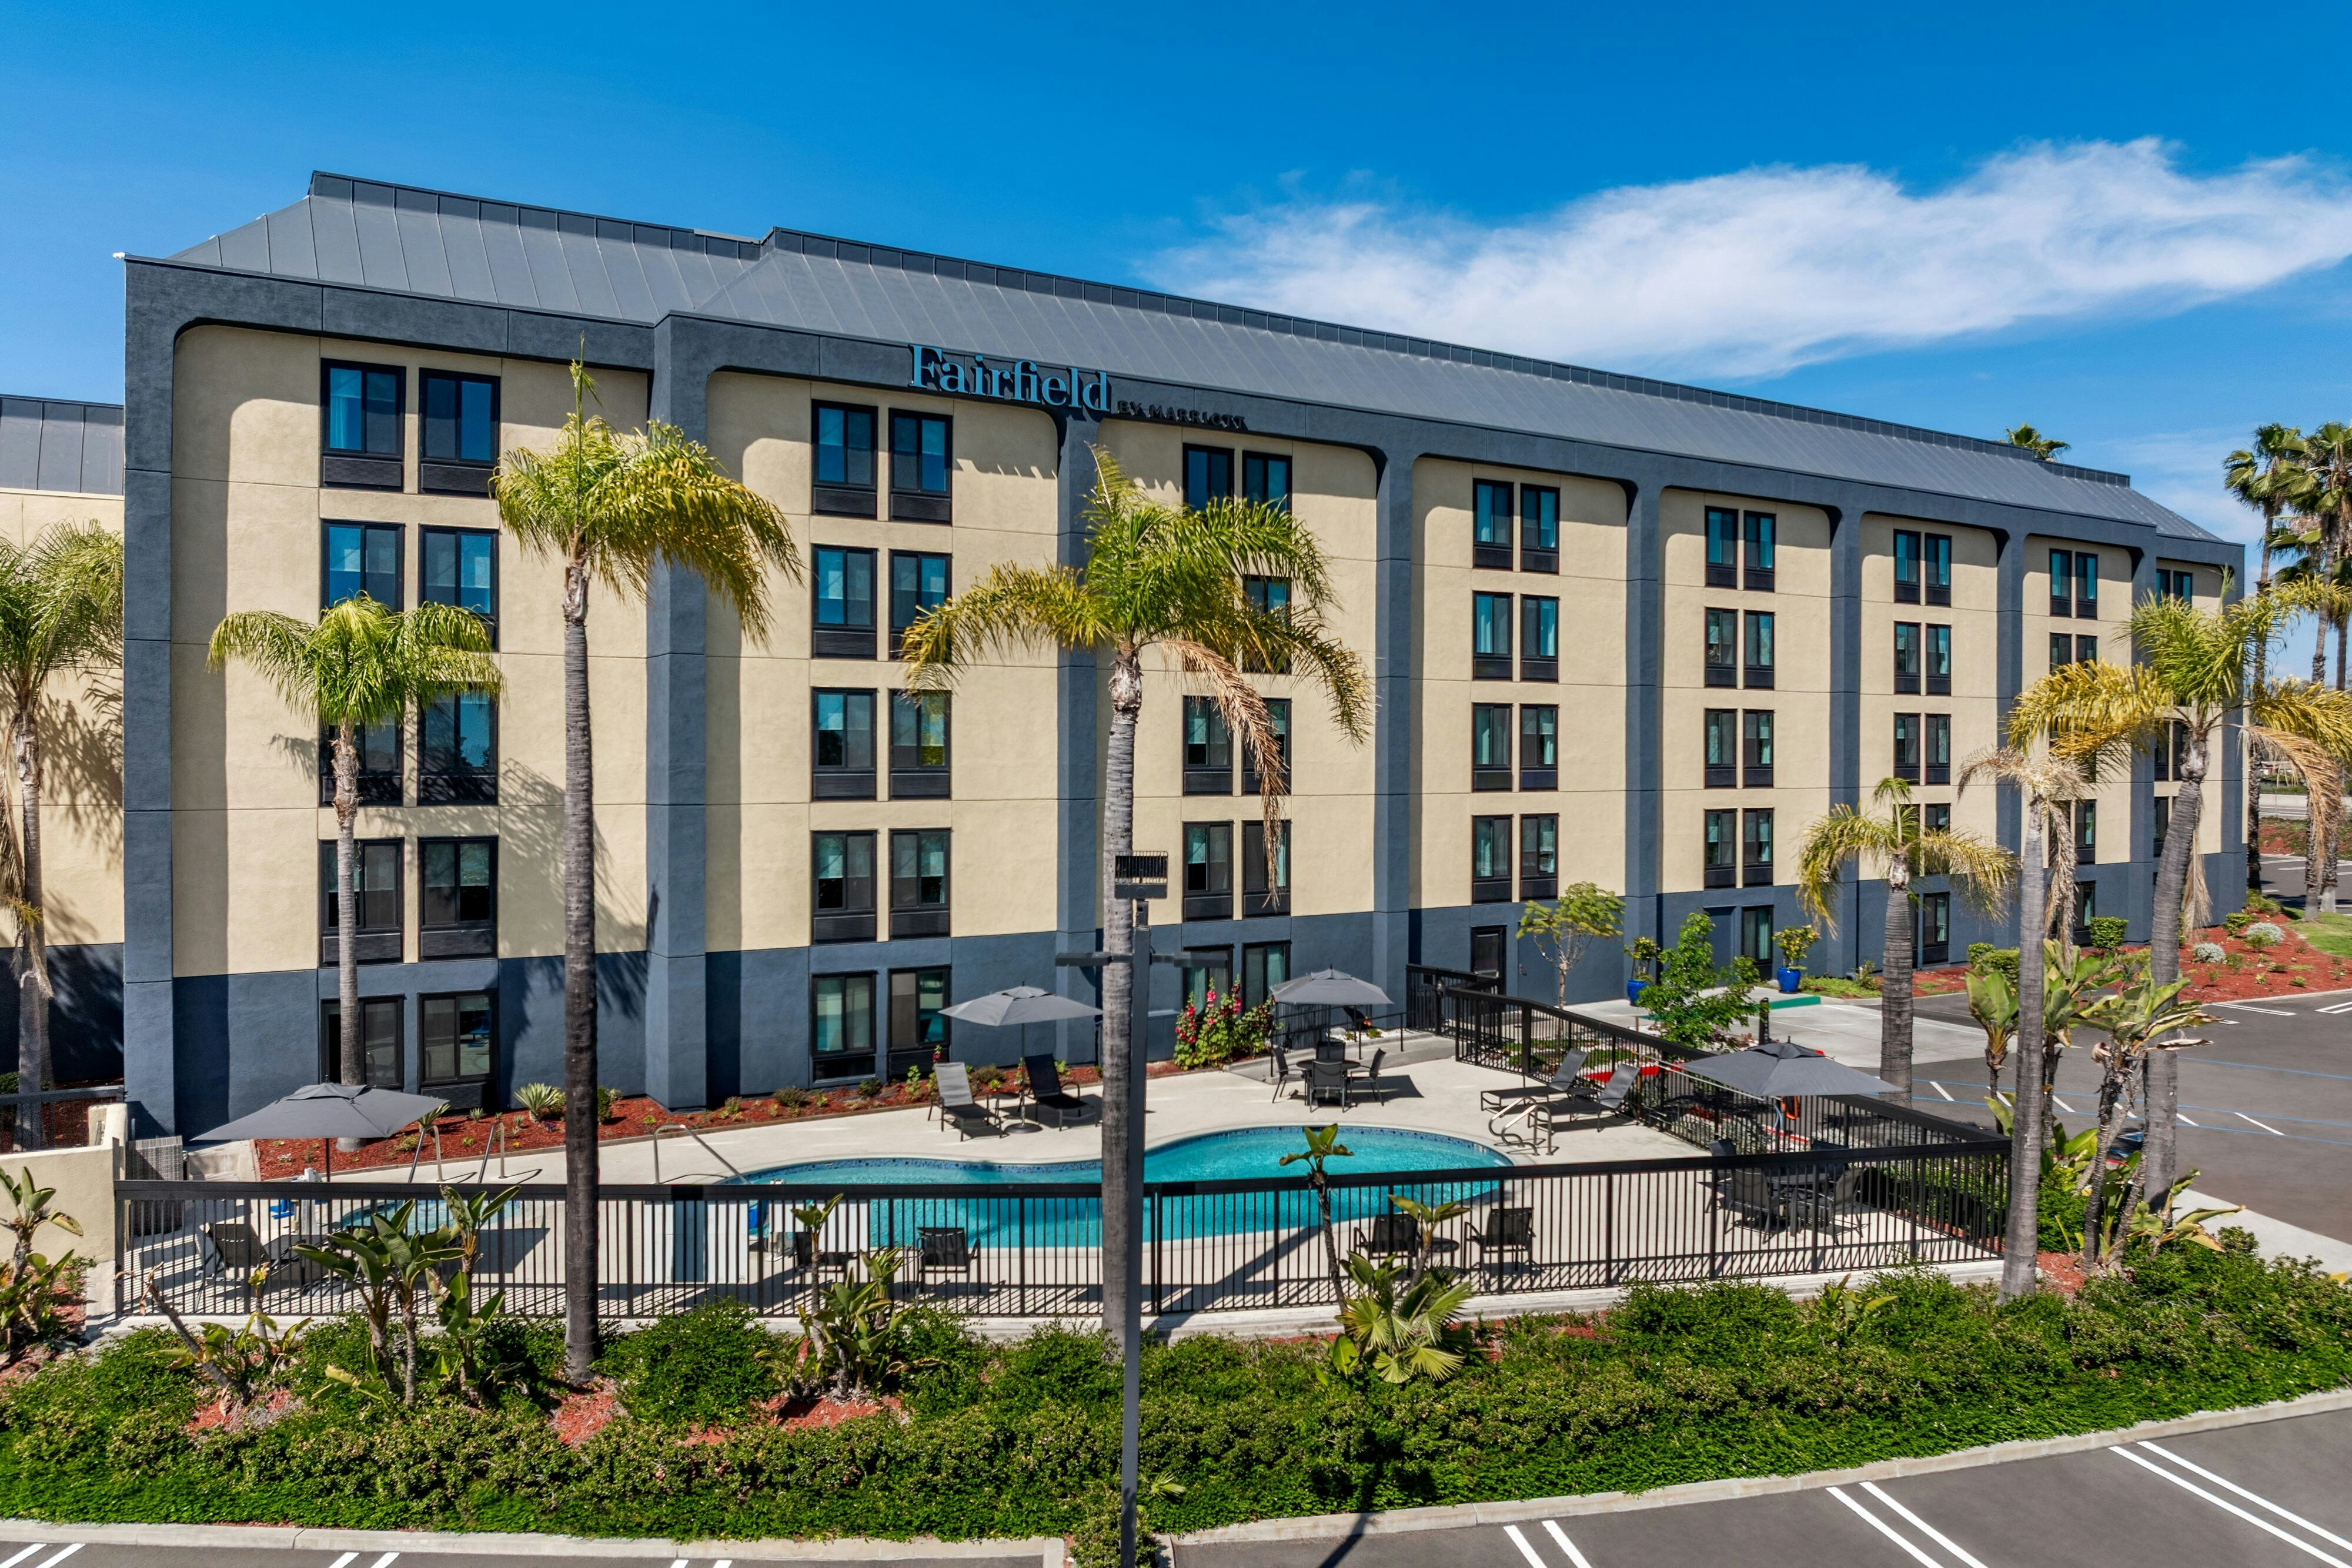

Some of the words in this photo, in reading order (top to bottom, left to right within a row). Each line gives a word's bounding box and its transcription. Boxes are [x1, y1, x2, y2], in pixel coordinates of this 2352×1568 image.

[910, 344, 1110, 412] Fairfield
[1118, 400, 1142, 416] BY
[1148, 404, 1245, 429] MARRIOTT
